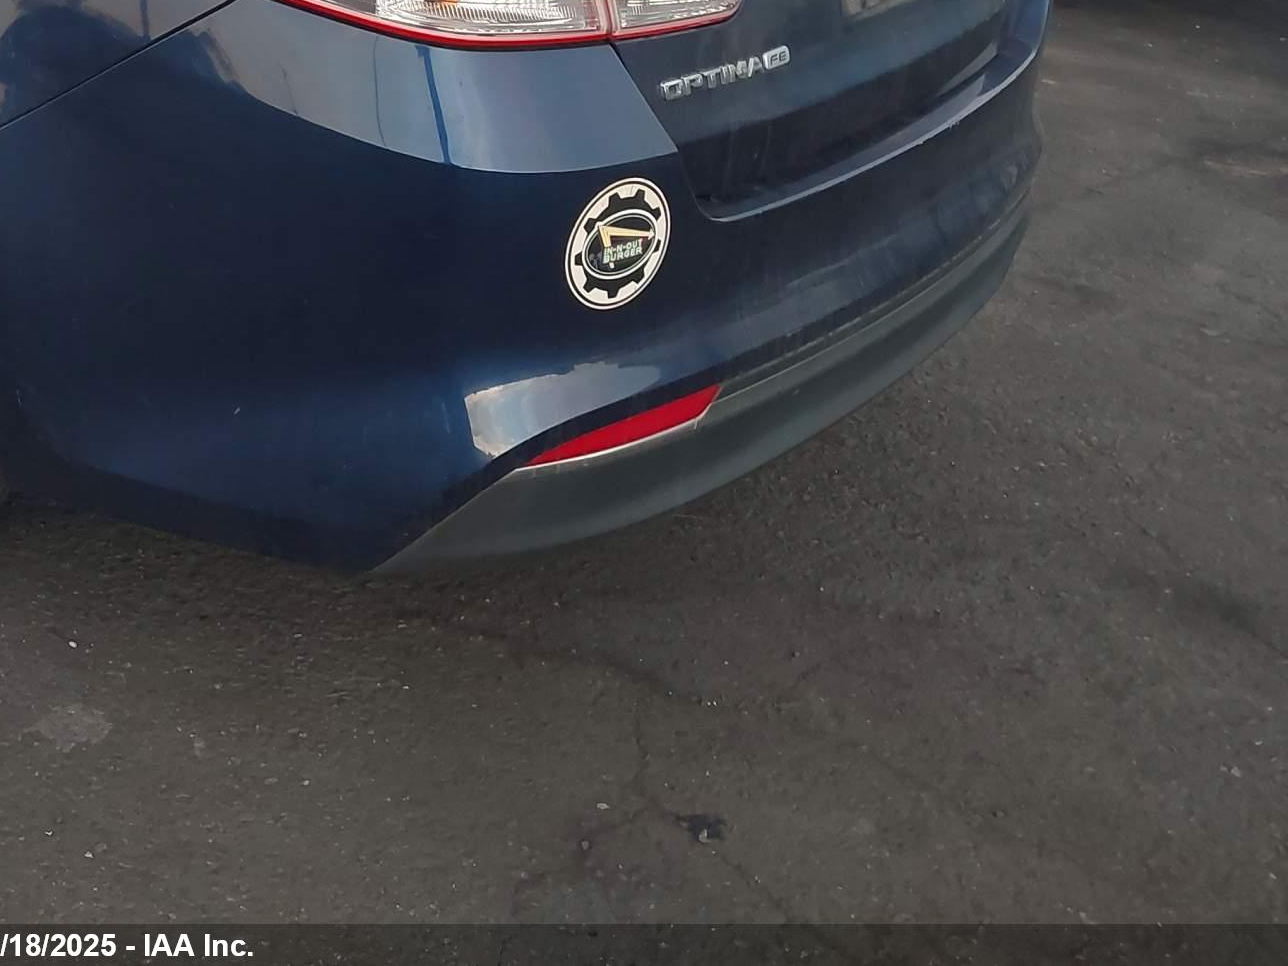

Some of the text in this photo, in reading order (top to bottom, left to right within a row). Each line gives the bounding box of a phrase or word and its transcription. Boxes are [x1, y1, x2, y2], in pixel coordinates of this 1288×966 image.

[660, 56, 763, 101] OPTIMA
[603, 247, 643, 264] BURGER
[604, 237, 643, 256] IN-N-OUT
